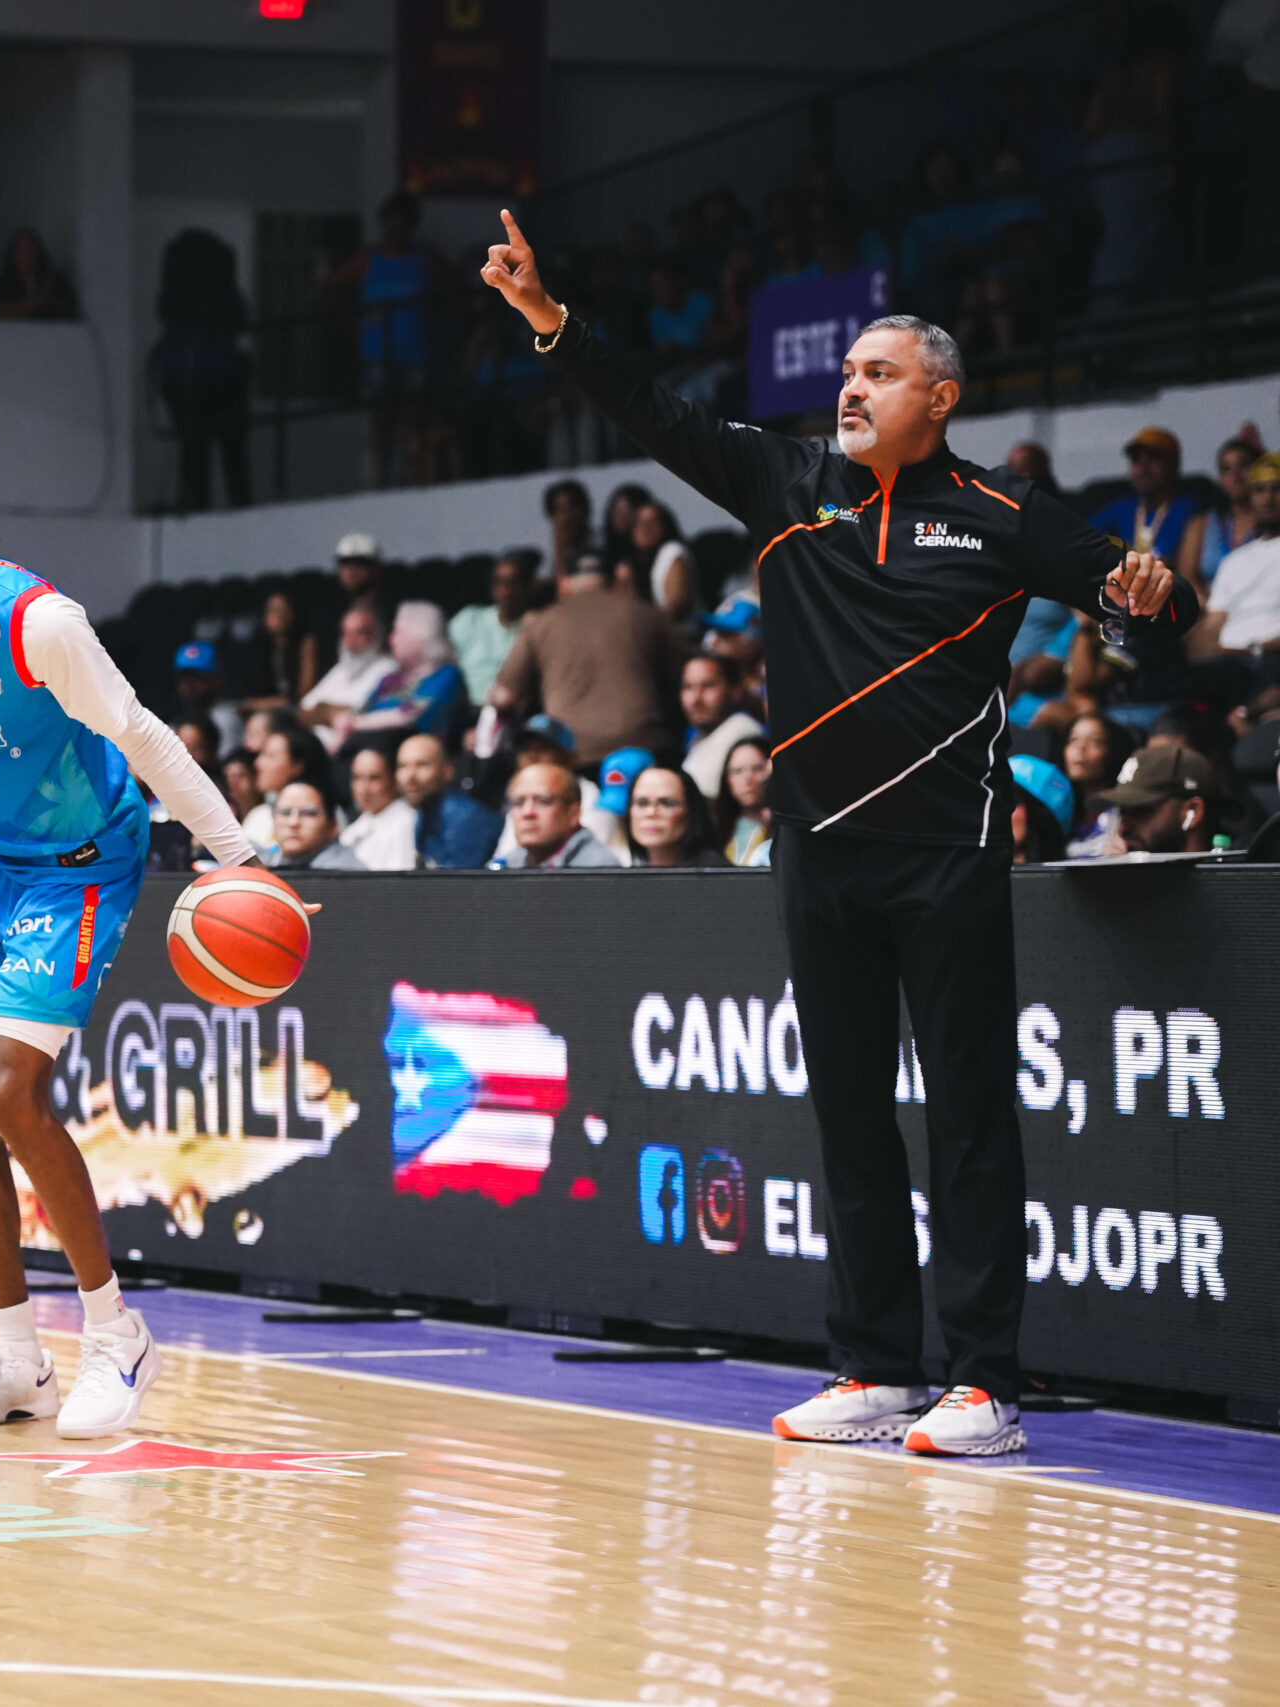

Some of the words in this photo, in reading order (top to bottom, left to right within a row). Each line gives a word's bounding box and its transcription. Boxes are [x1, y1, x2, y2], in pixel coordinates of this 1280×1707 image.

[914, 522, 948, 535] SAN
[914, 534, 982, 551] GERMÁN
[78, 905, 94, 964] GIGANTES
[105, 998, 333, 1159] GRILL
[632, 976, 1089, 1135] CANÓS,
[1111, 1004, 1227, 1120] PR
